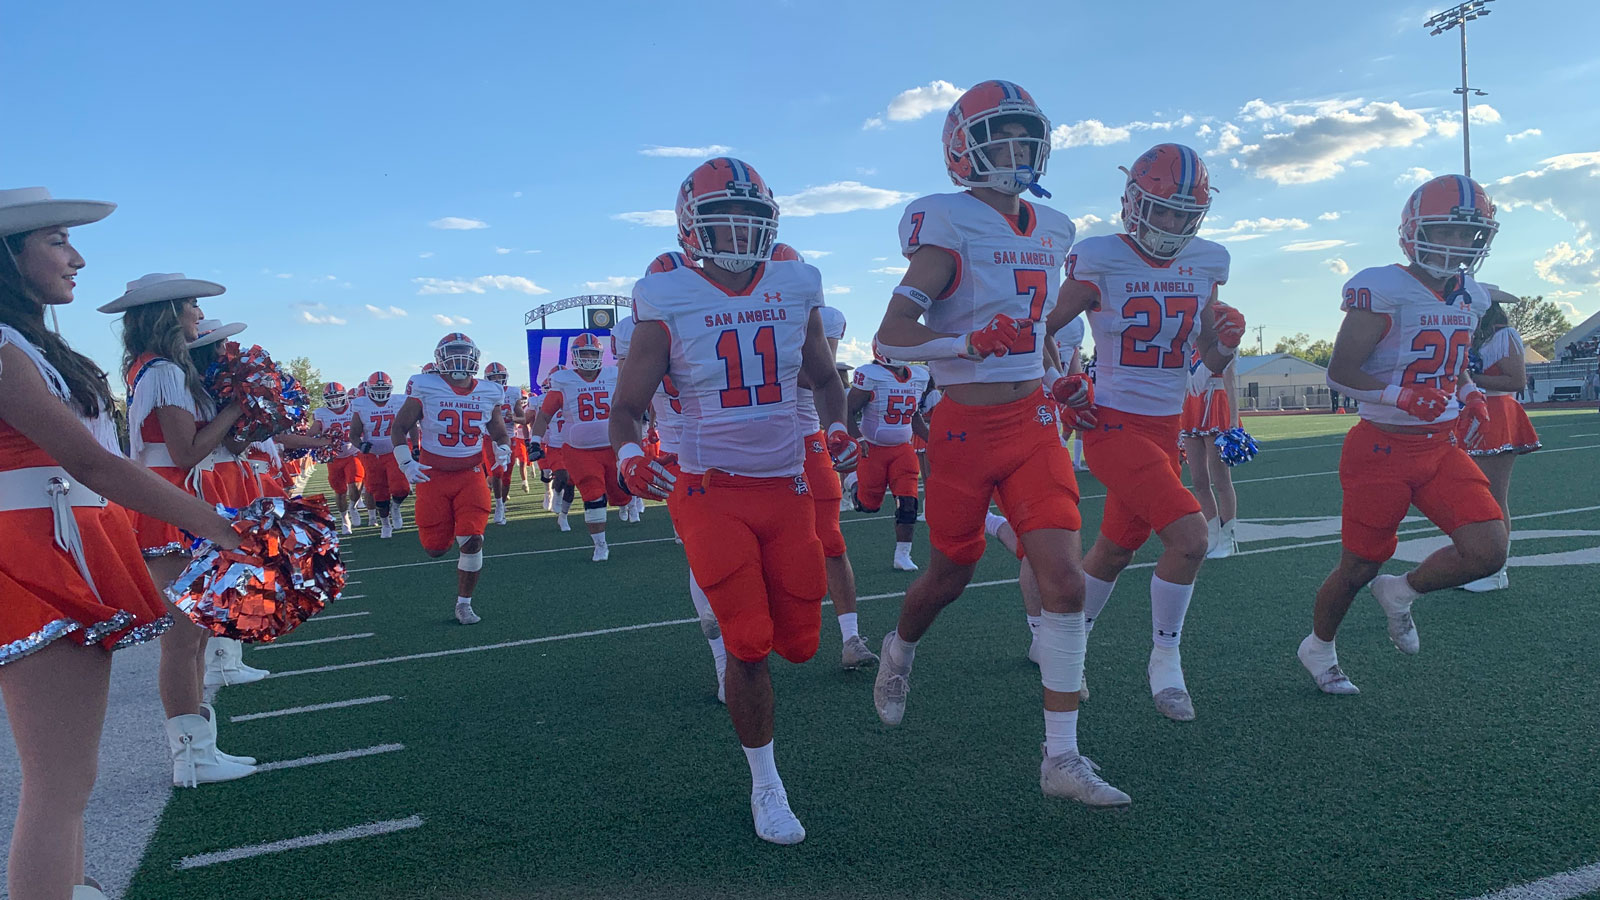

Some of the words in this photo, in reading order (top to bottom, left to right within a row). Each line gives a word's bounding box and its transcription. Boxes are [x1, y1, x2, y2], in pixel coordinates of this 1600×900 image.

[908, 211, 926, 246] 7
[994, 251, 1017, 265] SAN
[1020, 252, 1055, 267] ANGELO
[1125, 282, 1150, 293] SAN
[1153, 282, 1194, 293] ANGELO
[1345, 287, 1372, 312] 20
[704, 311, 733, 328] SAN
[737, 308, 787, 325] ANGELO
[1008, 268, 1048, 356] 7
[1420, 314, 1440, 326] SAN
[1441, 314, 1472, 326] ANGELO
[1119, 295, 1199, 369] 27
[715, 325, 783, 409] 11
[1399, 328, 1470, 395] 20
[853, 370, 866, 387] 52
[455, 402, 480, 410] ANGELO
[577, 391, 611, 422] 65
[883, 395, 917, 425] 52
[369, 413, 396, 437] 77
[437, 408, 483, 447] 35
